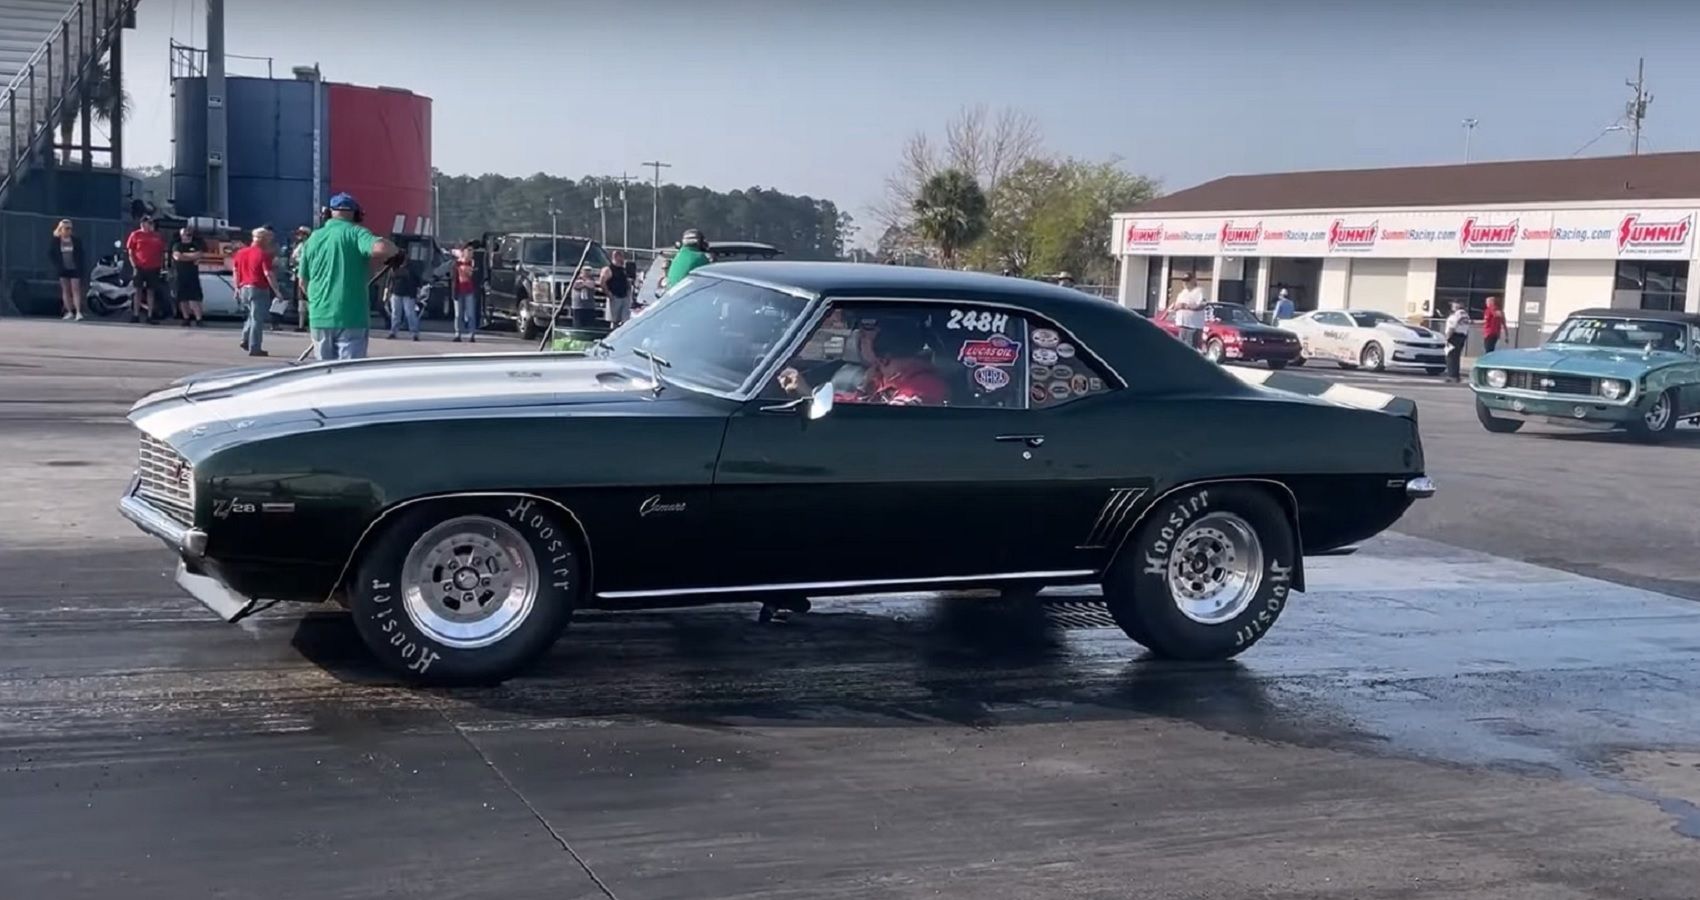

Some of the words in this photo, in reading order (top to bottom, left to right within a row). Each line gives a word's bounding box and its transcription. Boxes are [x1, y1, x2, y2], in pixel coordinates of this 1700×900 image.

[1164, 230, 1216, 242] SummitRacing.com
[1264, 230, 1325, 242] SummitRacing.com
[1381, 229, 1456, 242] SummitRacing.com
[1521, 228, 1611, 241] SummitRacing.com
[947, 309, 1008, 333] 248H
[966, 346, 995, 357] LUCAS
[996, 347, 1012, 357] OIL
[980, 369, 1004, 384] NHRA
[1144, 489, 1209, 582] Hoosier
[506, 497, 572, 592] Hoosier
